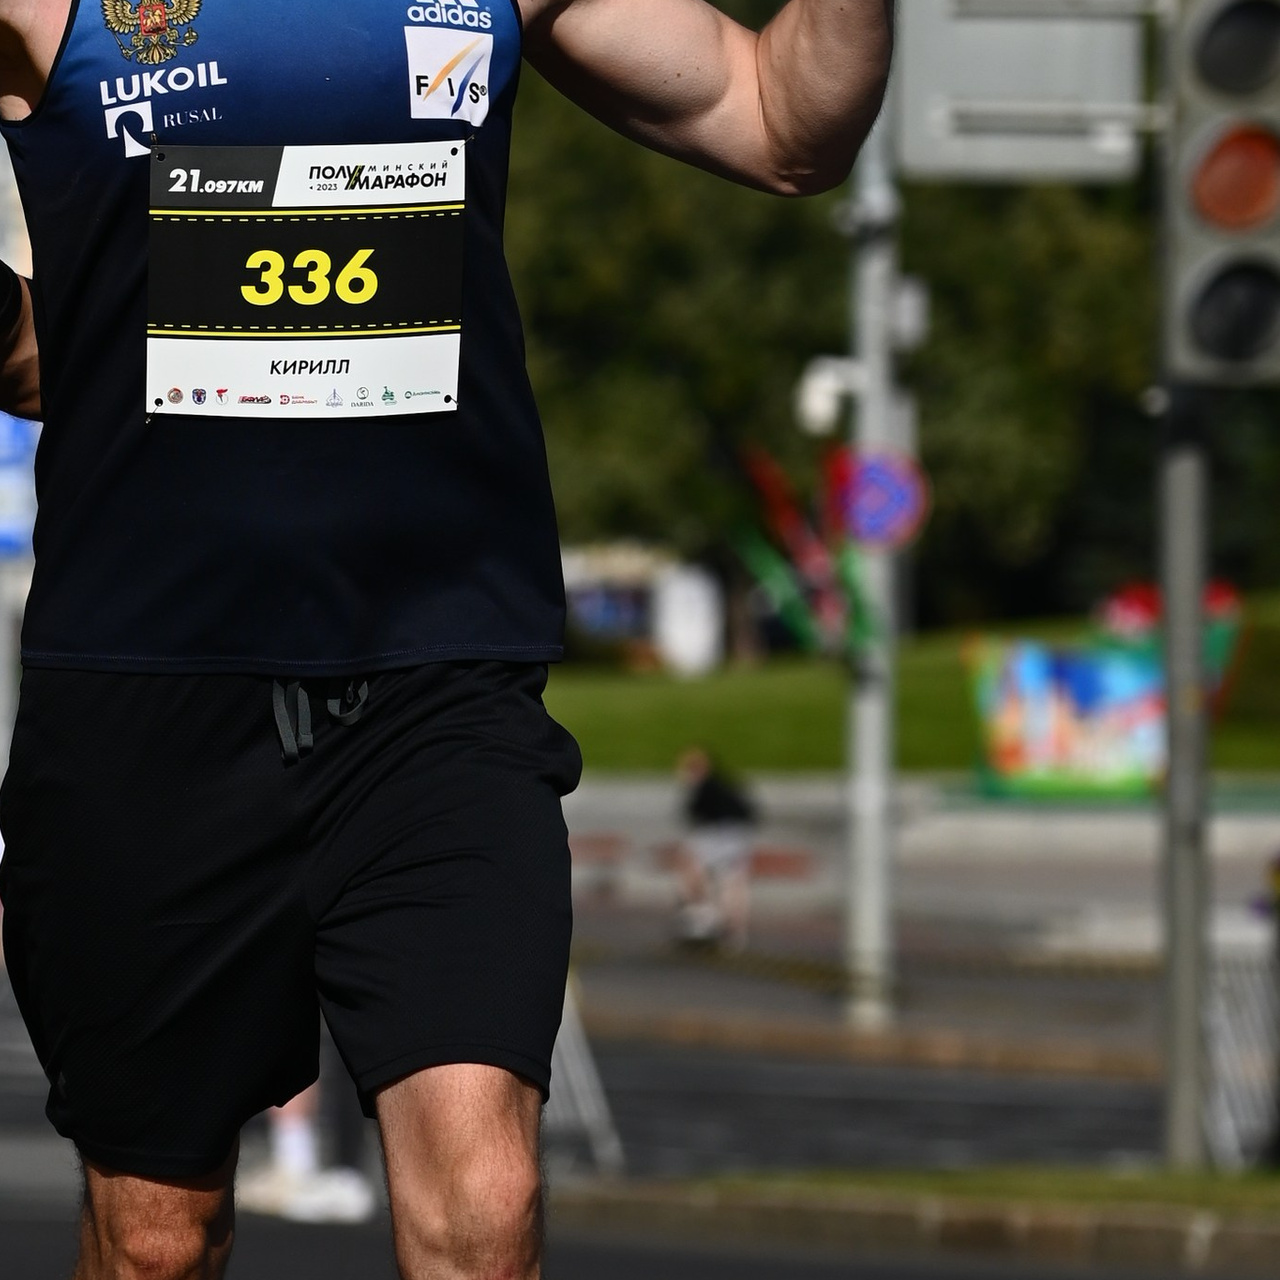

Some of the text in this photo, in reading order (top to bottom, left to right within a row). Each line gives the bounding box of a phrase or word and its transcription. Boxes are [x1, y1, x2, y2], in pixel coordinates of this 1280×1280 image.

[407, 3, 492, 29] adidas
[100, 61, 228, 106] LUKOIL
[163, 107, 223, 128] RUSAL
[367, 160, 448, 173] МИНСКИЙ
[316, 183, 338, 191] 2023
[349, 172, 447, 190] МАРАФОН
[240, 249, 378, 306] 336
[270, 359, 351, 375] КИРИЛЛ
